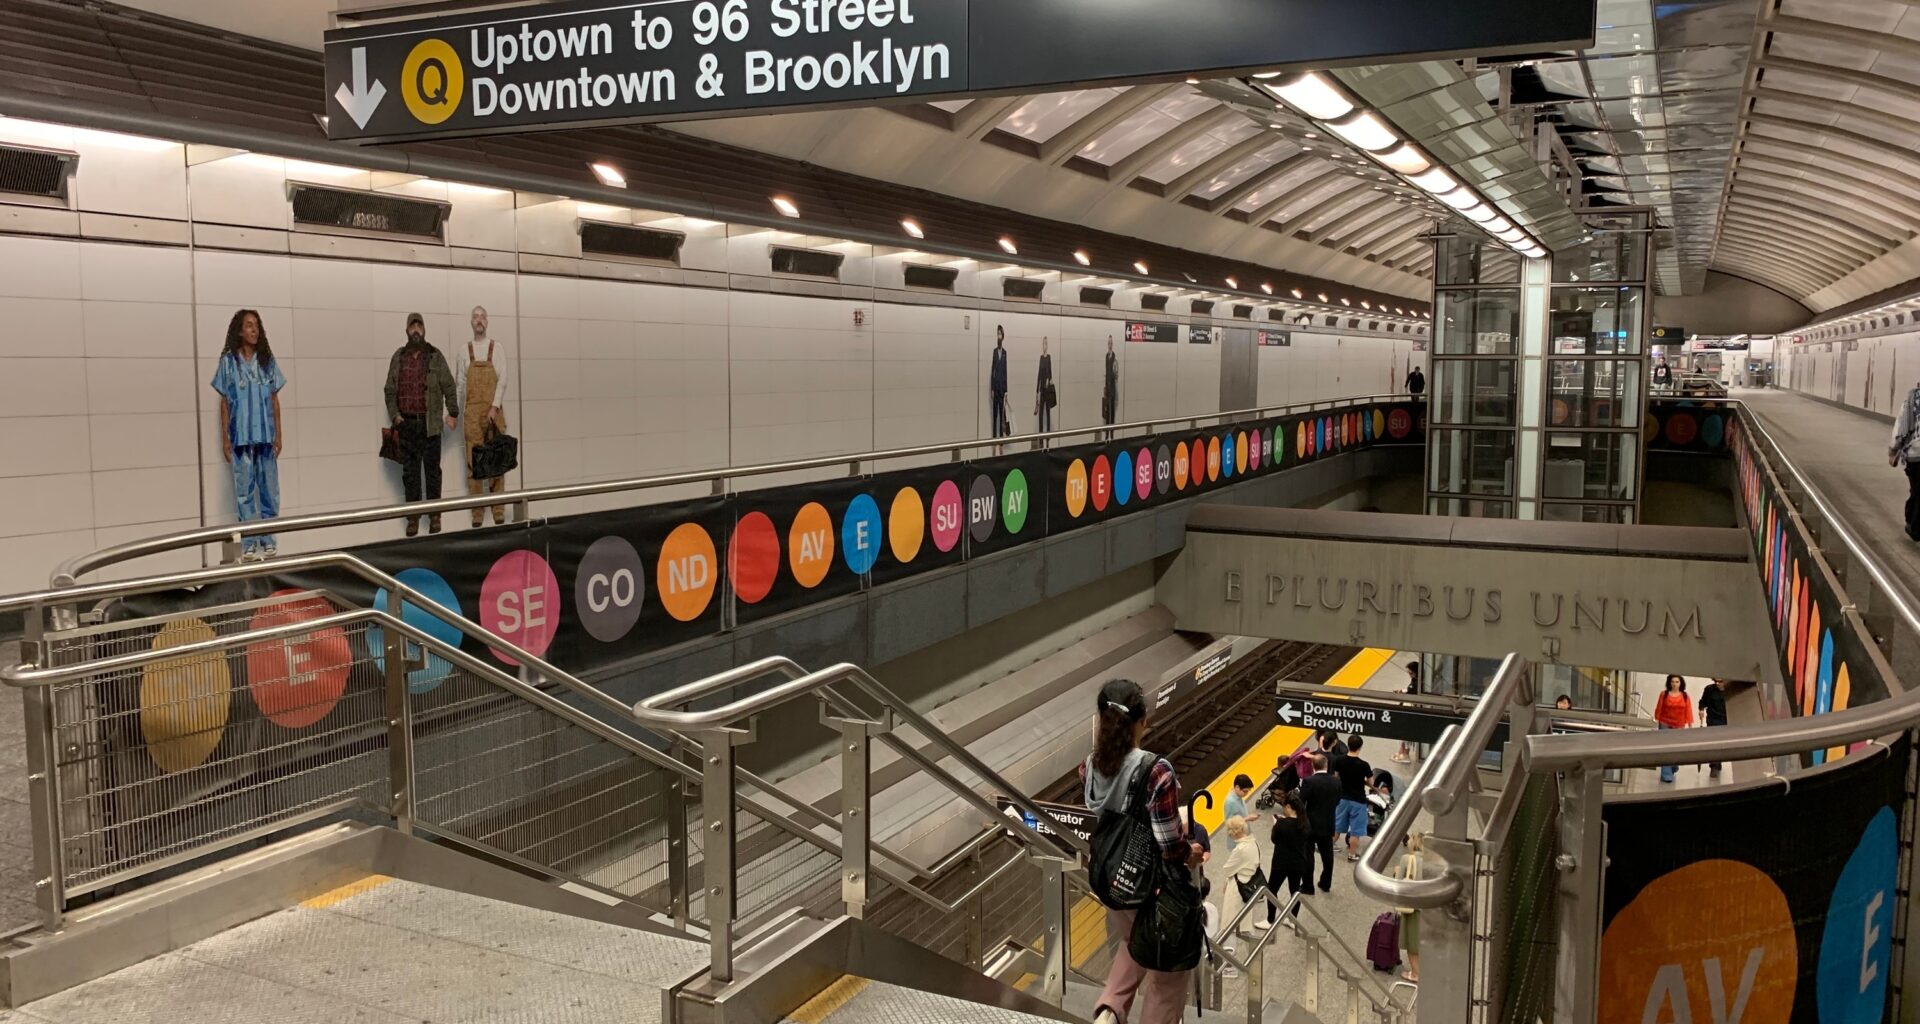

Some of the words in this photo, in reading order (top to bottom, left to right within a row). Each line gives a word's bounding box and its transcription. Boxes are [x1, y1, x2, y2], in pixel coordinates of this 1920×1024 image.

[470, 22, 613, 74] Uptown
[632, 9, 673, 52] to
[692, 0, 749, 45] 96
[770, 0, 914, 38] Street
[416, 57, 448, 105] Q
[472, 66, 676, 117] Downtown
[696, 54, 725, 99] &
[745, 38, 950, 96] Brooklyn
[1391, 418, 1407, 430] SU
[1070, 478, 1083, 500] TH
[1097, 473, 1105, 494] E
[1138, 464, 1150, 485] SE
[1158, 460, 1169, 480] CO
[1176, 457, 1187, 475] ND
[1226, 448, 1231, 465] E
[283, 633, 316, 687] E
[496, 585, 547, 634] SE
[587, 568, 635, 613] CO
[668, 554, 708, 594] ND
[799, 529, 825, 564] AV
[856, 520, 869, 550] E
[937, 503, 957, 532] SU
[972, 496, 995, 523] BW
[1007, 490, 1024, 516] AY
[1225, 570, 1243, 602] E
[1266, 574, 1502, 623] PLURIBUS
[1531, 593, 1707, 640] UNUM
[1303, 702, 1376, 721] Downtown
[1381, 710, 1392, 723] &
[1303, 715, 1364, 733] Brooklyn
[1116, 874, 1136, 890] YOGA.
[1118, 867, 1125, 876] IS
[1121, 861, 1138, 874] THIS
[1641, 947, 1765, 1024] AV
[1858, 889, 1884, 994] E
